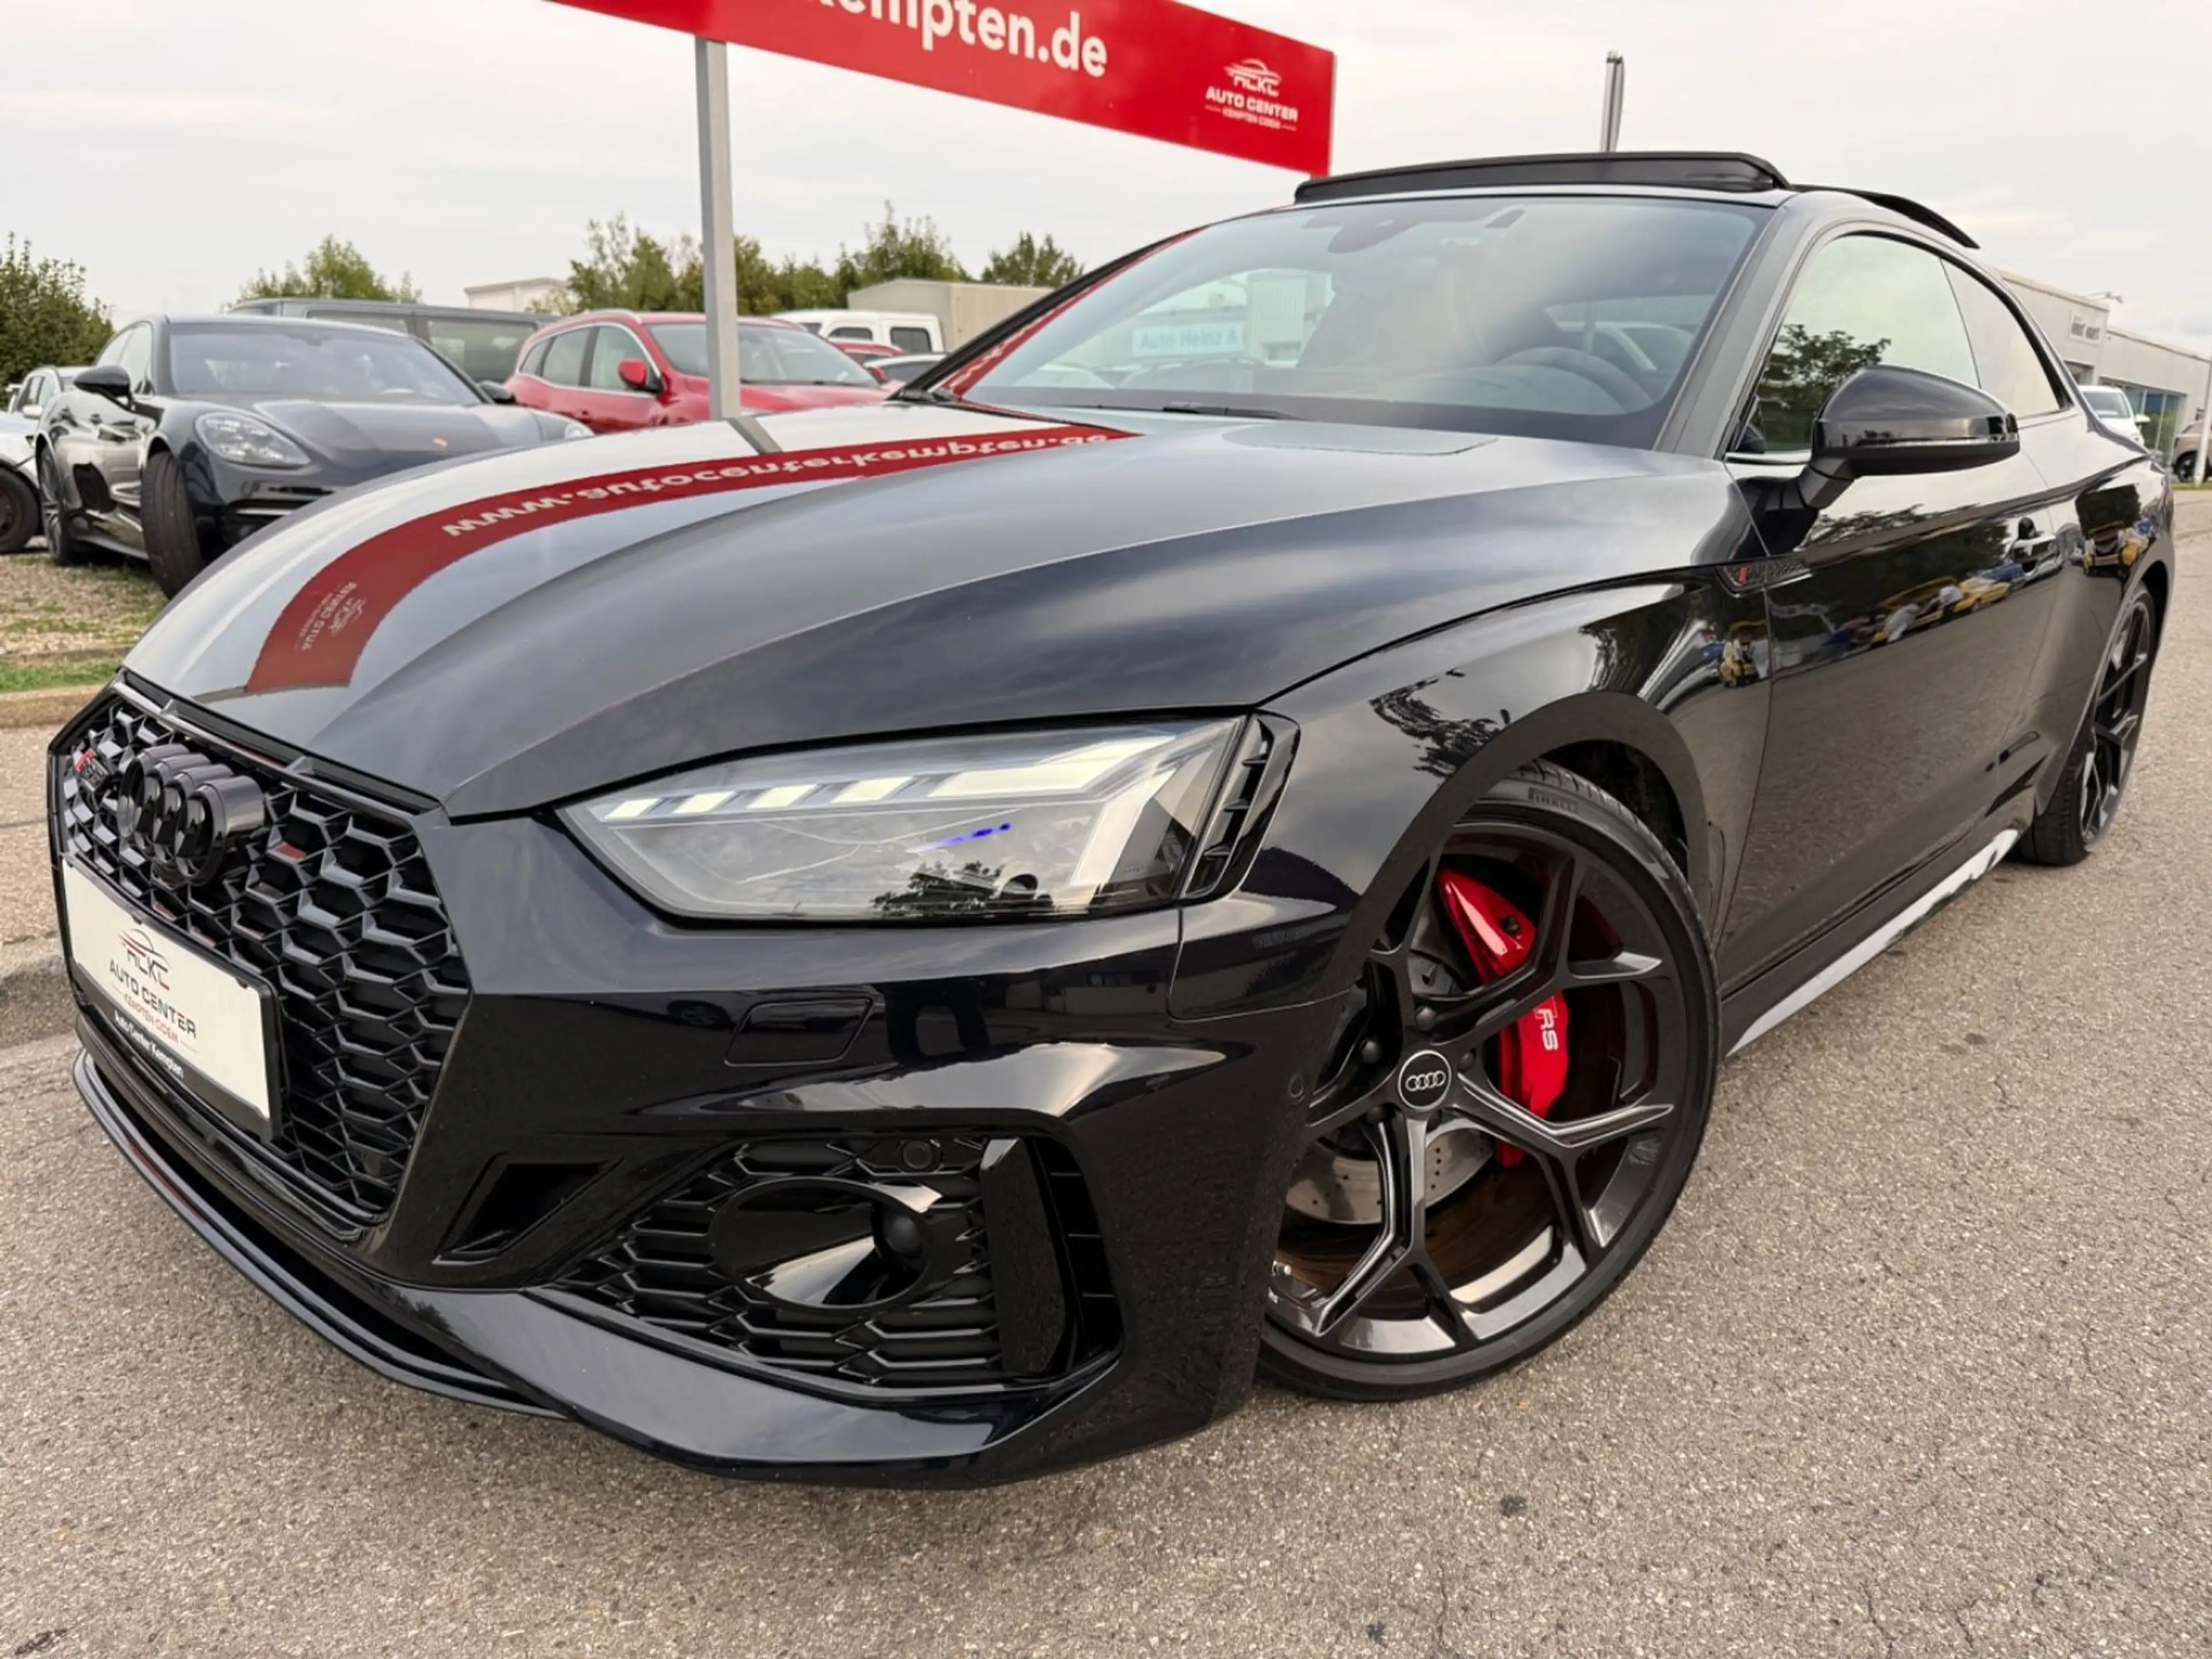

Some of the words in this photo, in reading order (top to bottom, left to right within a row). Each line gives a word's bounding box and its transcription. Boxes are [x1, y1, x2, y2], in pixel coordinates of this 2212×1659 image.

[1205, 86, 1245, 108] AUTO
[1247, 96, 1298, 123] CENTER
[109, 959, 139, 995] AUTO
[142, 986, 196, 1039] CENTER
[1537, 1009, 1559, 1051] RS
